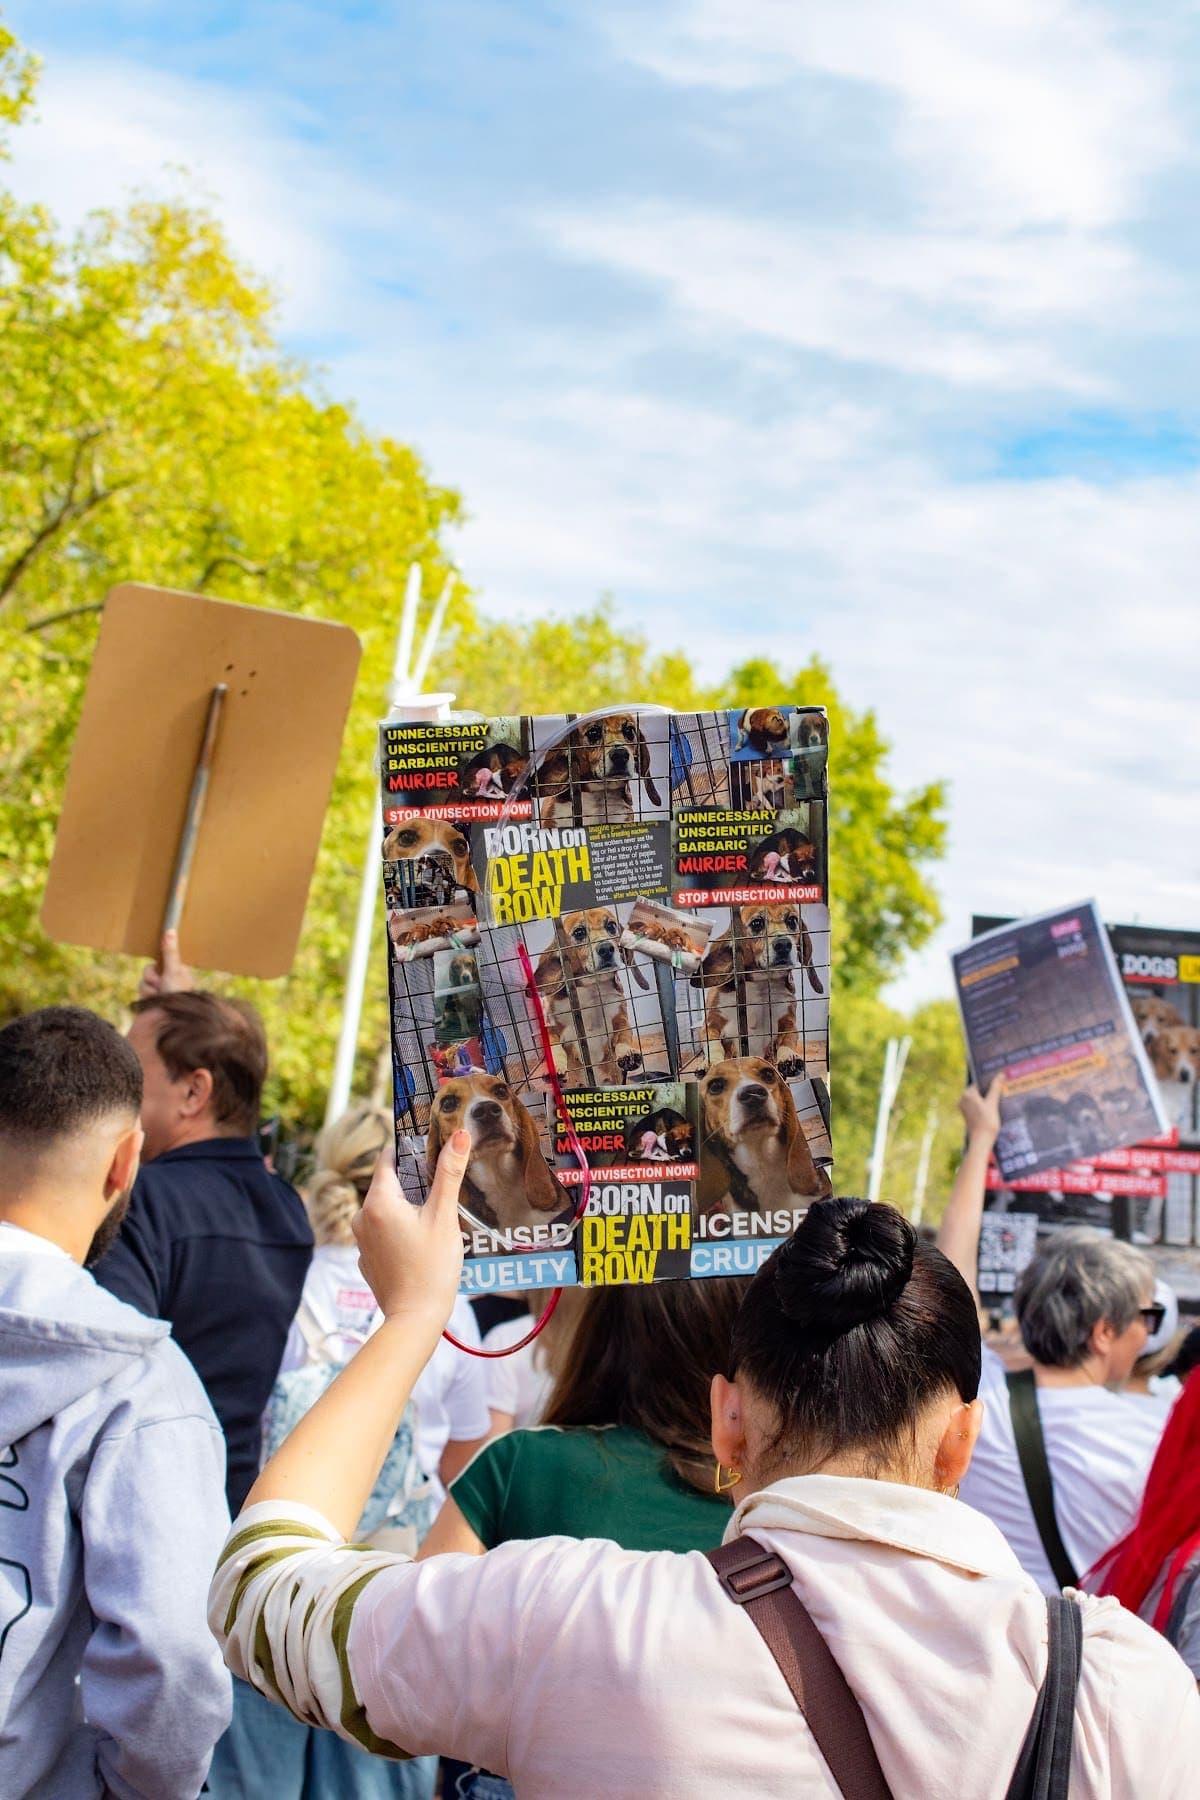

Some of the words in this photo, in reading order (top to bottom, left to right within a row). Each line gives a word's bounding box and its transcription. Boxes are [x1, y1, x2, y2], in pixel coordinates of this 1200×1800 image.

[387, 725, 489, 740] UNNECESSARY
[387, 741, 485, 755] UNSCIENTIFIC
[388, 756, 459, 770] BARBARIC
[389, 771, 460, 791] MURDER
[390, 809, 420, 822] STOP
[423, 804, 499, 819] VIVISECTION
[501, 803, 532, 816] NOW!
[678, 810, 778, 824] UNNECESSARY
[484, 823, 557, 859] BORN
[559, 827, 587, 849] on
[678, 825, 774, 838] UNSCIENTIFIC
[678, 840, 748, 853] BARBARIC
[487, 846, 591, 894] DEATH
[678, 855, 748, 874] MURDER
[678, 891, 708, 904] STOP
[711, 889, 782, 902] VIVISECTION
[785, 887, 818, 899] NOW!
[492, 886, 562, 926] ROW
[557, 1120, 625, 1133] BRBARIC
[557, 1134, 625, 1152] MRDER
[590, 1166, 663, 1181] VIVISECTION
[665, 1165, 696, 1178] NOW!
[584, 1183, 662, 1217] BORN
[664, 1193, 690, 1214] on
[692, 1208, 809, 1239] ICENSE
[460, 1223, 573, 1254] CENSED
[583, 1214, 691, 1253] DEATH
[690, 1244, 780, 1273] CRUE
[458, 1257, 569, 1289] RUELTY
[583, 1250, 658, 1287] ROW
